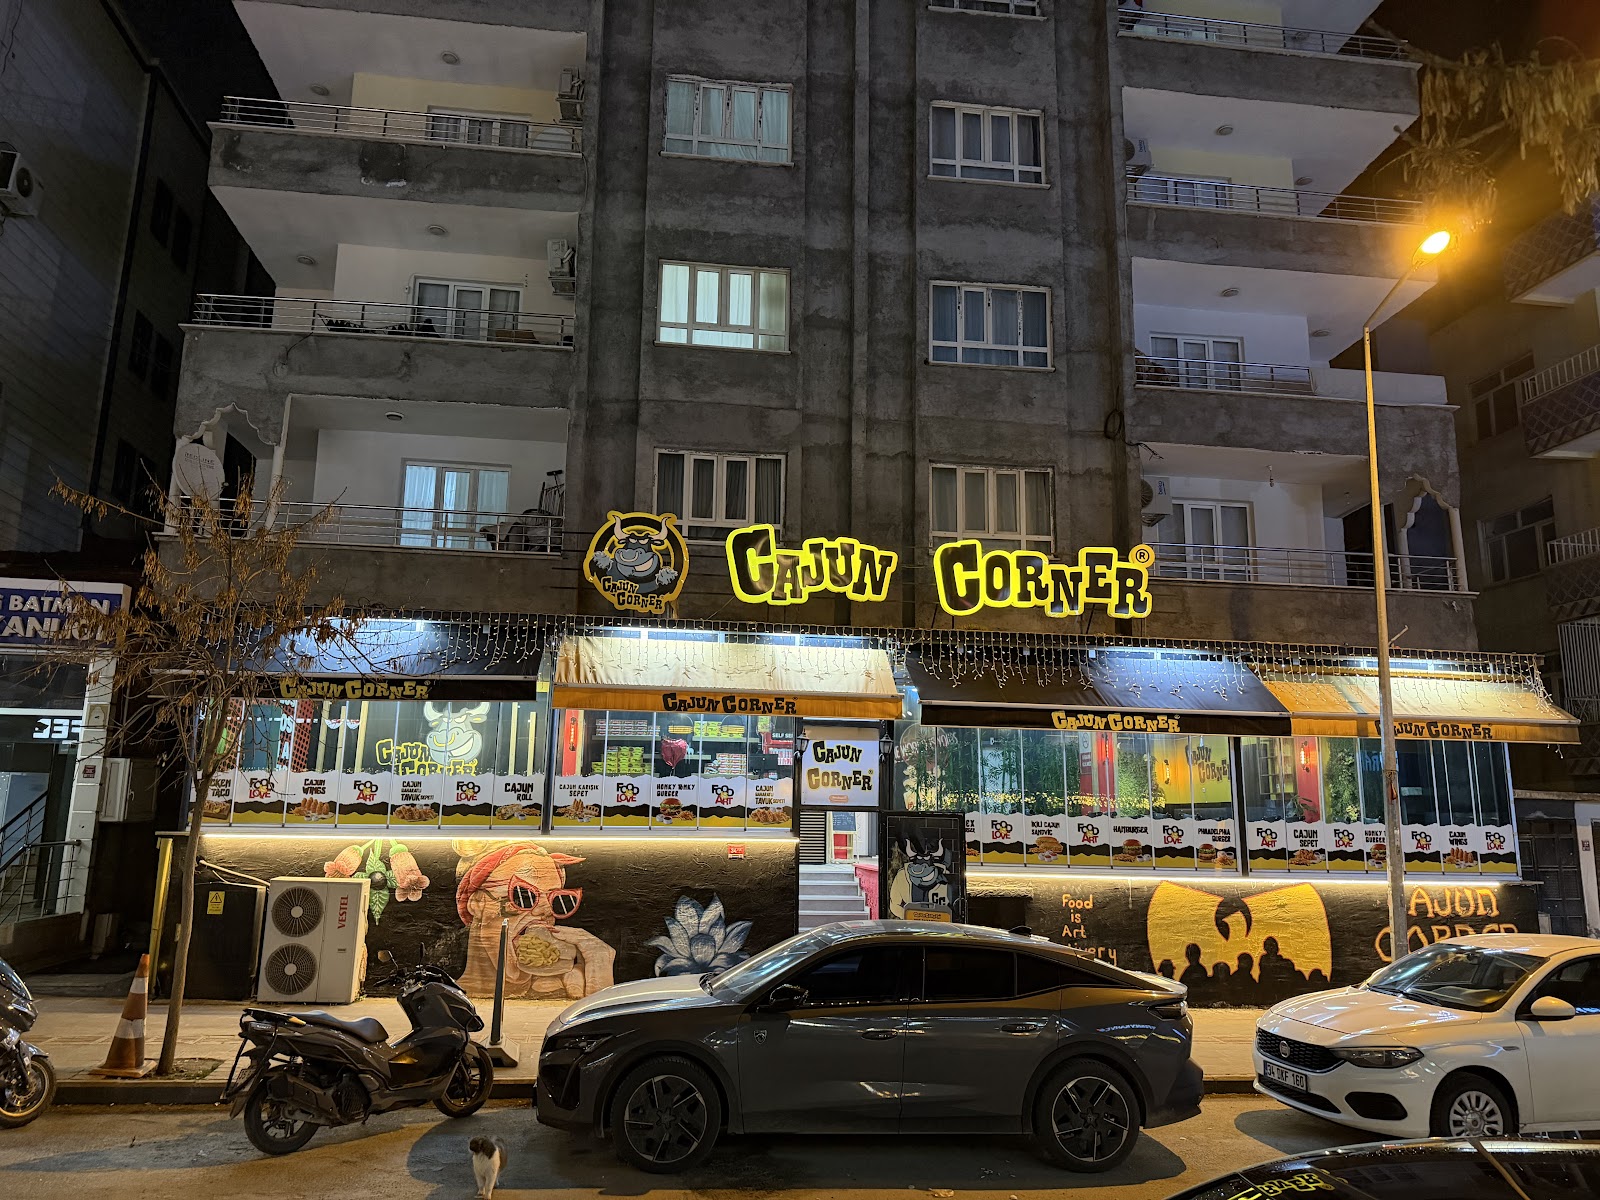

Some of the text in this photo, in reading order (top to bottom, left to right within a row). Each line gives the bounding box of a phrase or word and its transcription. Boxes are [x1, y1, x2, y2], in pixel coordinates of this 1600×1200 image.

[726, 525, 897, 603] CAJUN
[602, 577, 637, 593] CAJUN
[9, 595, 110, 615] BATMN
[616, 591, 662, 610] CORNER
[280, 678, 428, 699] CAJUN CORNER
[662, 693, 797, 714] CAJUN CORNER
[1051, 711, 1180, 733] CAJUN CORNER
[1426, 721, 1492, 739] CORNER
[813, 741, 862, 763] CAJUN
[1185, 745, 1211, 766] CAJUN
[250, 778, 274, 790] FOOD
[304, 778, 326, 786] CAJUN
[354, 780, 379, 793] FOOD
[456, 781, 481, 793] FOOD
[504, 782, 534, 793] CAJUN
[212, 788, 231, 798] TACO
[249, 790, 271, 798] LOVE
[302, 787, 326, 795] WINGS
[616, 783, 640, 795] FOOD
[711, 784, 735, 797] FOOD
[356, 792, 377, 801] ART
[456, 792, 477, 801] LOVE
[616, 793, 637, 803] LOVE
[715, 796, 734, 805] ART
[755, 797, 773, 805] TAVUK
[991, 820, 1013, 832] FOOD
[1078, 823, 1099, 836] FOOD
[1113, 825, 1149, 834] HAMBURGER
[1163, 825, 1184, 837] FOOD
[991, 831, 1011, 840] LOVE
[1081, 834, 1099, 844] ART
[1163, 835, 1182, 845] LOVE
[1256, 828, 1278, 840] FOOD
[1293, 829, 1318, 839] CAJUN
[1333, 828, 1355, 841] FOOD
[1411, 831, 1432, 843] FOOD
[1485, 832, 1506, 844] FOOD
[1260, 838, 1277, 848] ART
[1300, 840, 1318, 848] SEPET
[1335, 839, 1353, 848] LOVE
[1416, 841, 1432, 851] ART
[1487, 842, 1504, 851] LOVE
[1062, 894, 1094, 909] Food
[1407, 887, 1500, 918] AJUN
[337, 895, 349, 929] VESTEL
[1070, 909, 1081, 923] is
[1062, 924, 1087, 939] Art
[1267, 1064, 1275, 1077] 34
[1291, 1073, 1305, 1088] 160
